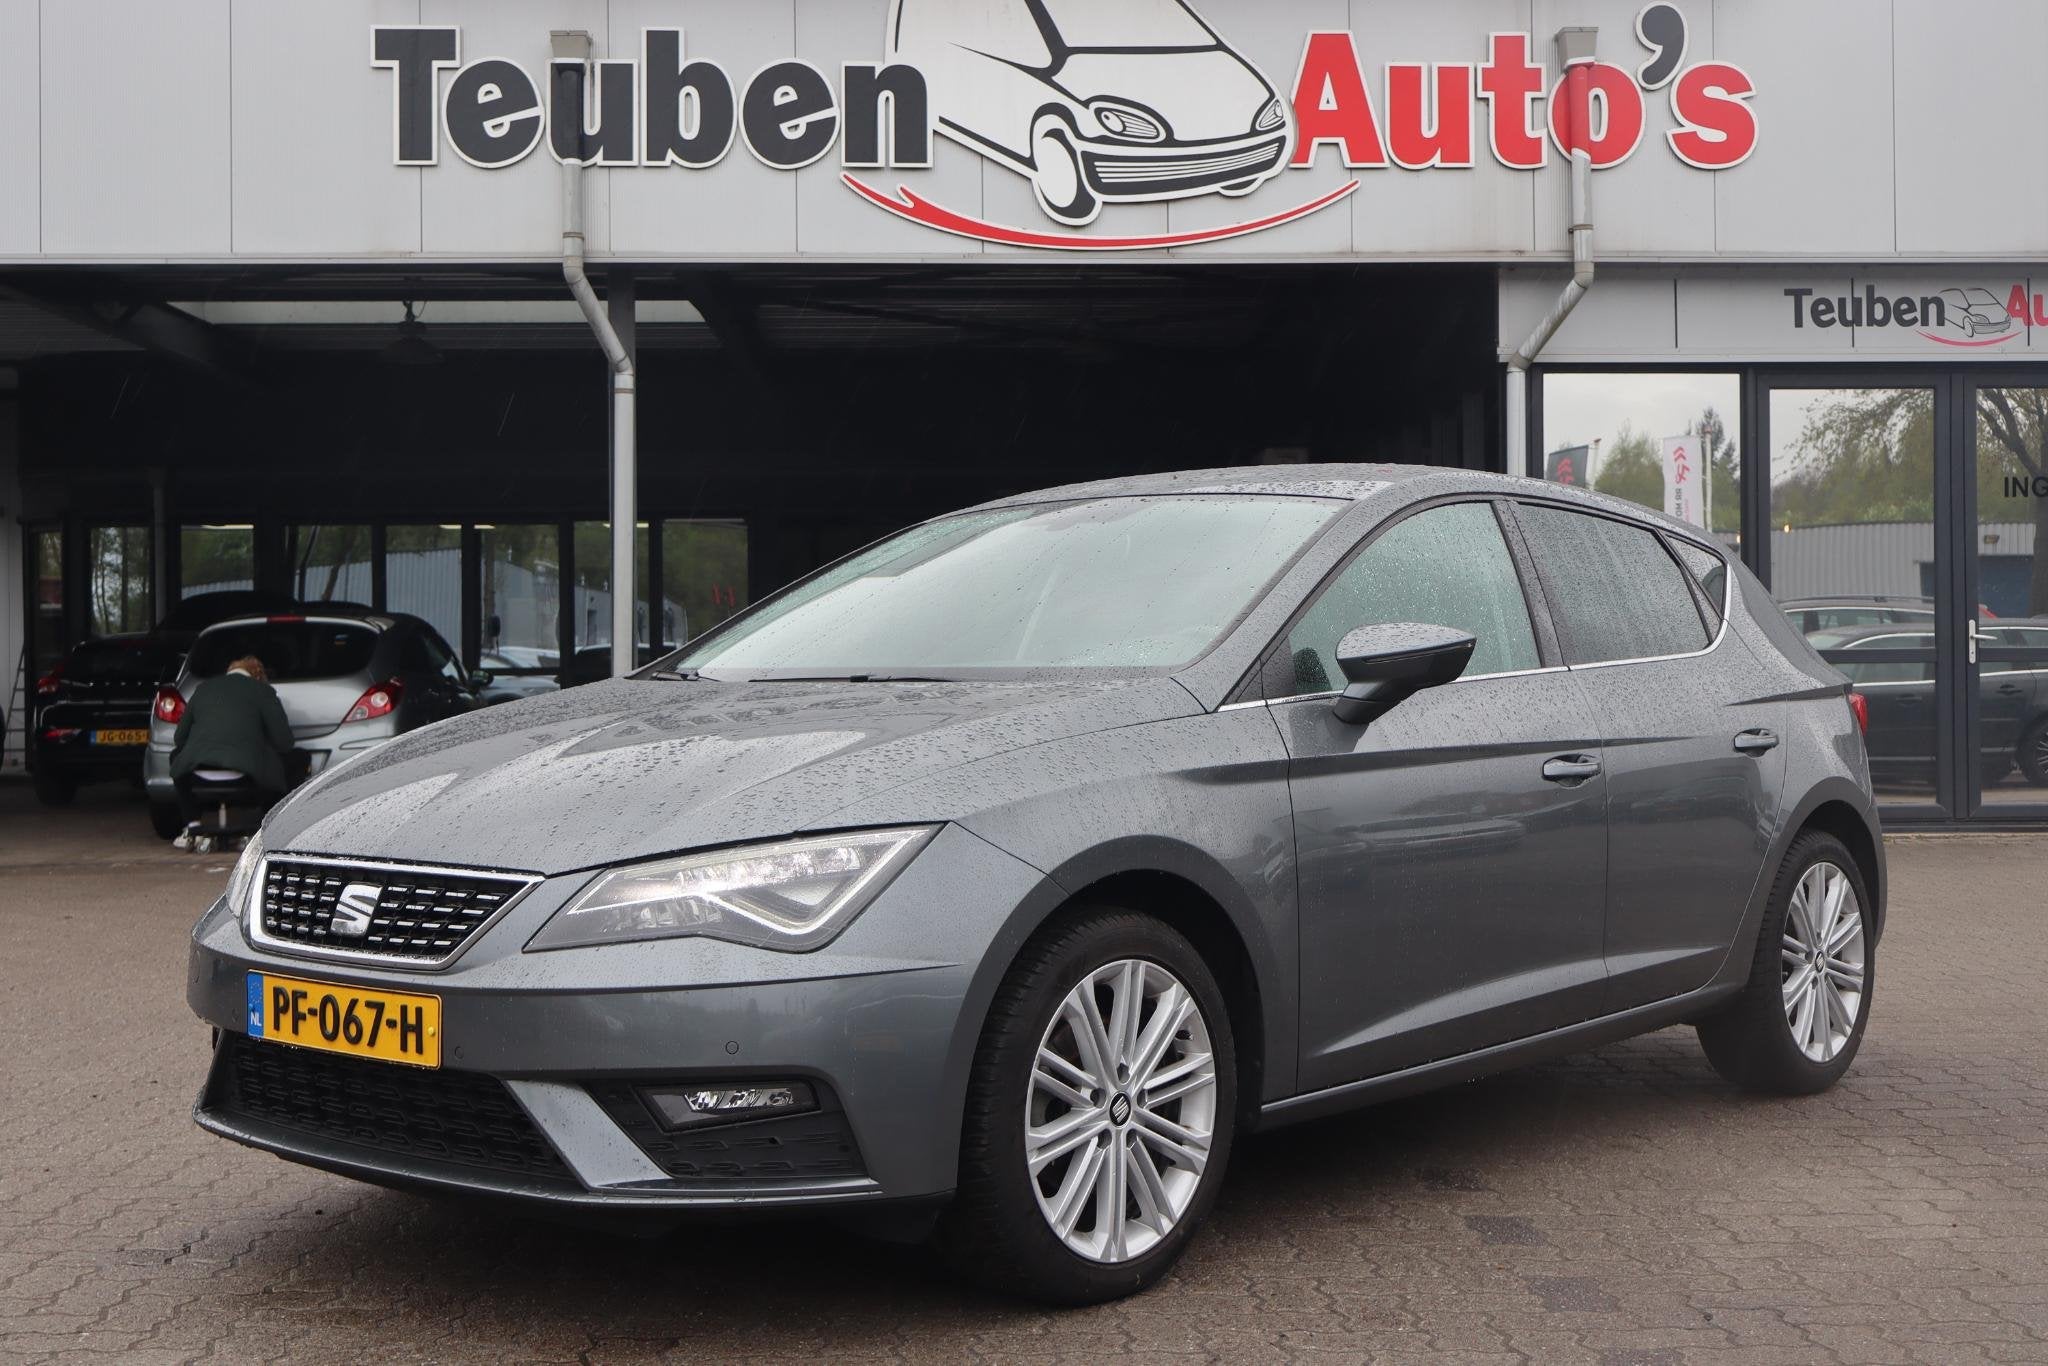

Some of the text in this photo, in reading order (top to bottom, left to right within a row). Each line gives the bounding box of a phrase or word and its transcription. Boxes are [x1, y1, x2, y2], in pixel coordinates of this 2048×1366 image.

[370, 1, 1759, 170] Teuben Auto's
[1784, 284, 1945, 328] Teuben
[2004, 477, 2048, 498] ING
[250, 1012, 262, 1027] NL
[272, 986, 423, 1055] PF-067-H
